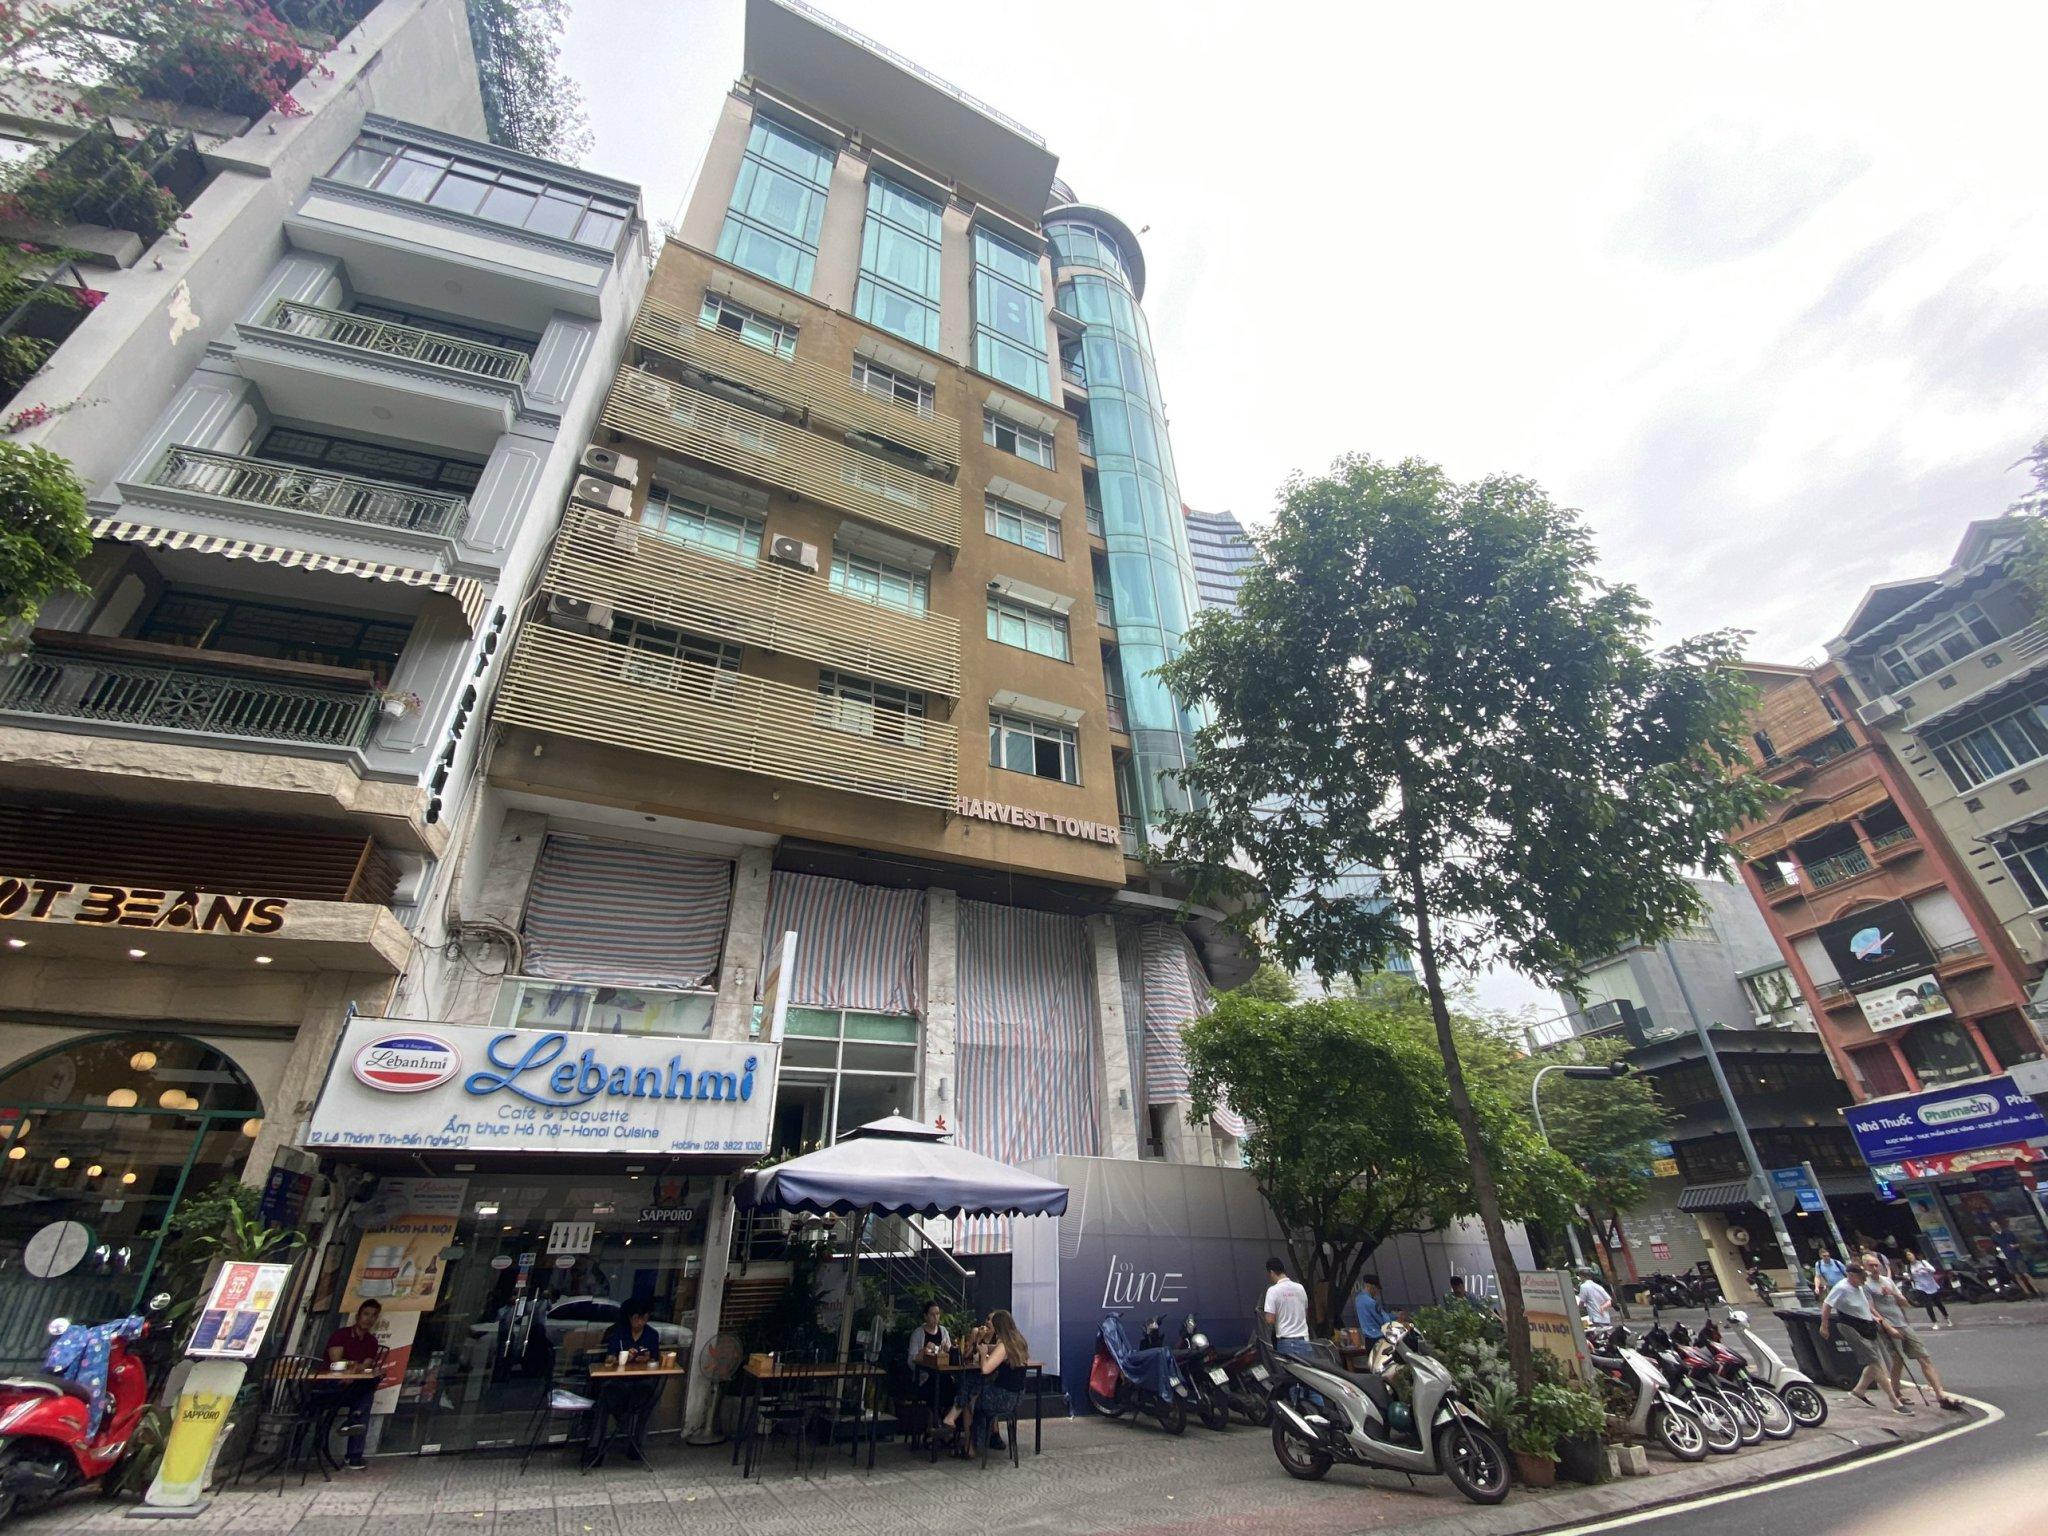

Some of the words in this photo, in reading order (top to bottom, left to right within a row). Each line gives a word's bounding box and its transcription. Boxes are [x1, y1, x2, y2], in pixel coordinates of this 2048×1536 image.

[956, 795, 1048, 831] HARVEST
[1052, 814, 1121, 845] TOWER
[74, 885, 288, 934] BEANS
[366, 1050, 448, 1069] Lebanhmi
[464, 1033, 758, 1107] Lebanhmi
[498, 1104, 536, 1120] Café
[559, 1108, 629, 1123] Baguette
[1924, 1099, 1993, 1121] Pharmacity
[1878, 1113, 1914, 1131] Thuốc
[613, 1125, 660, 1139] Cuisine
[703, 1140, 719, 1151] 028
[722, 1140, 743, 1151] 3822
[642, 1209, 693, 1221] SAPPORO
[183, 1410, 220, 1420] SAPPORO
